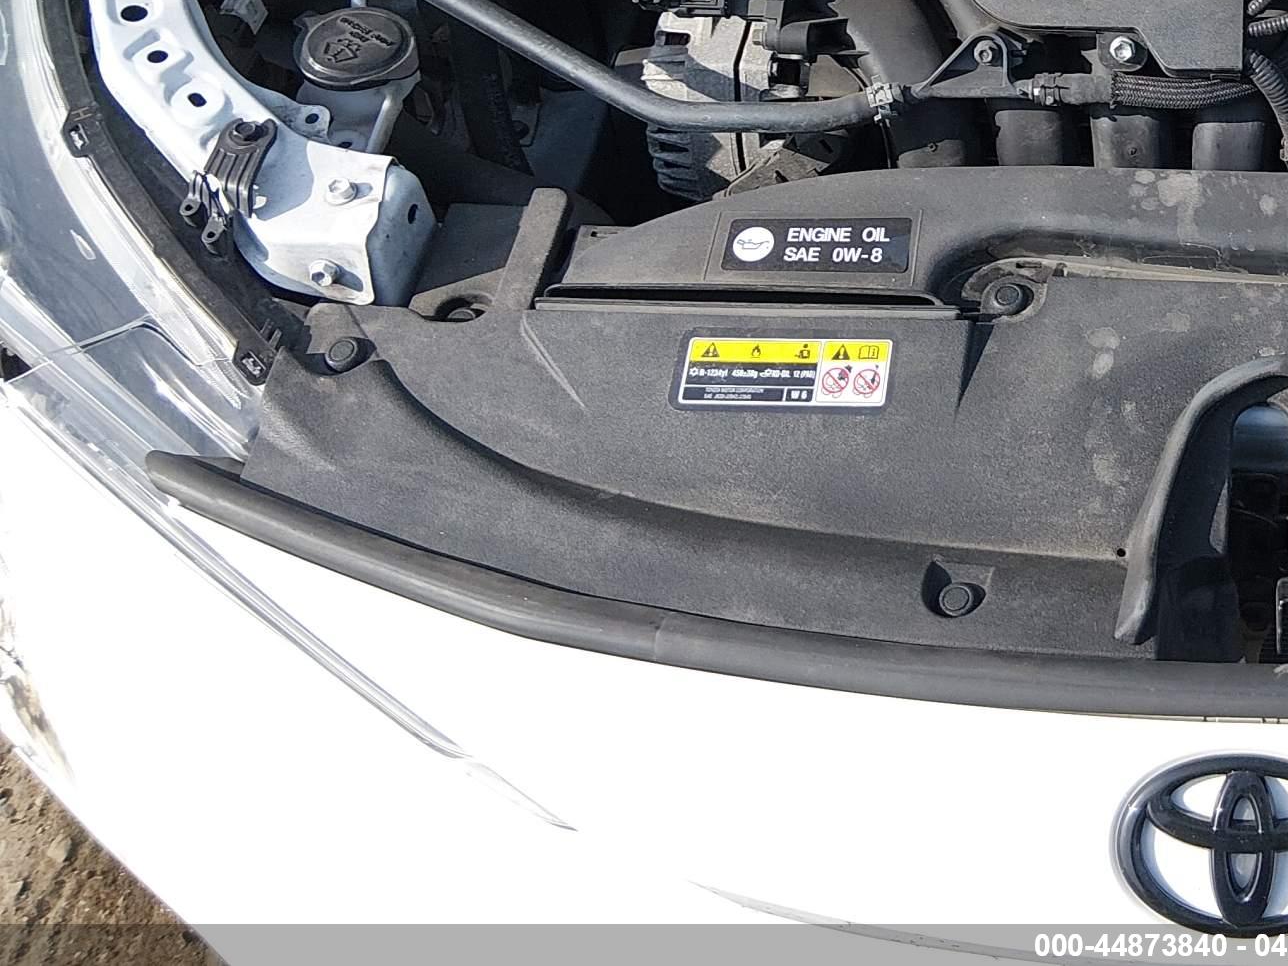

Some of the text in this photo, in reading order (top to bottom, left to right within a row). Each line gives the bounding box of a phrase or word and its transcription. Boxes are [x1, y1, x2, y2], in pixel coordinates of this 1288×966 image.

[787, 227, 890, 243] ENGINE OIL
[783, 247, 883, 263] SAE 0W-8
